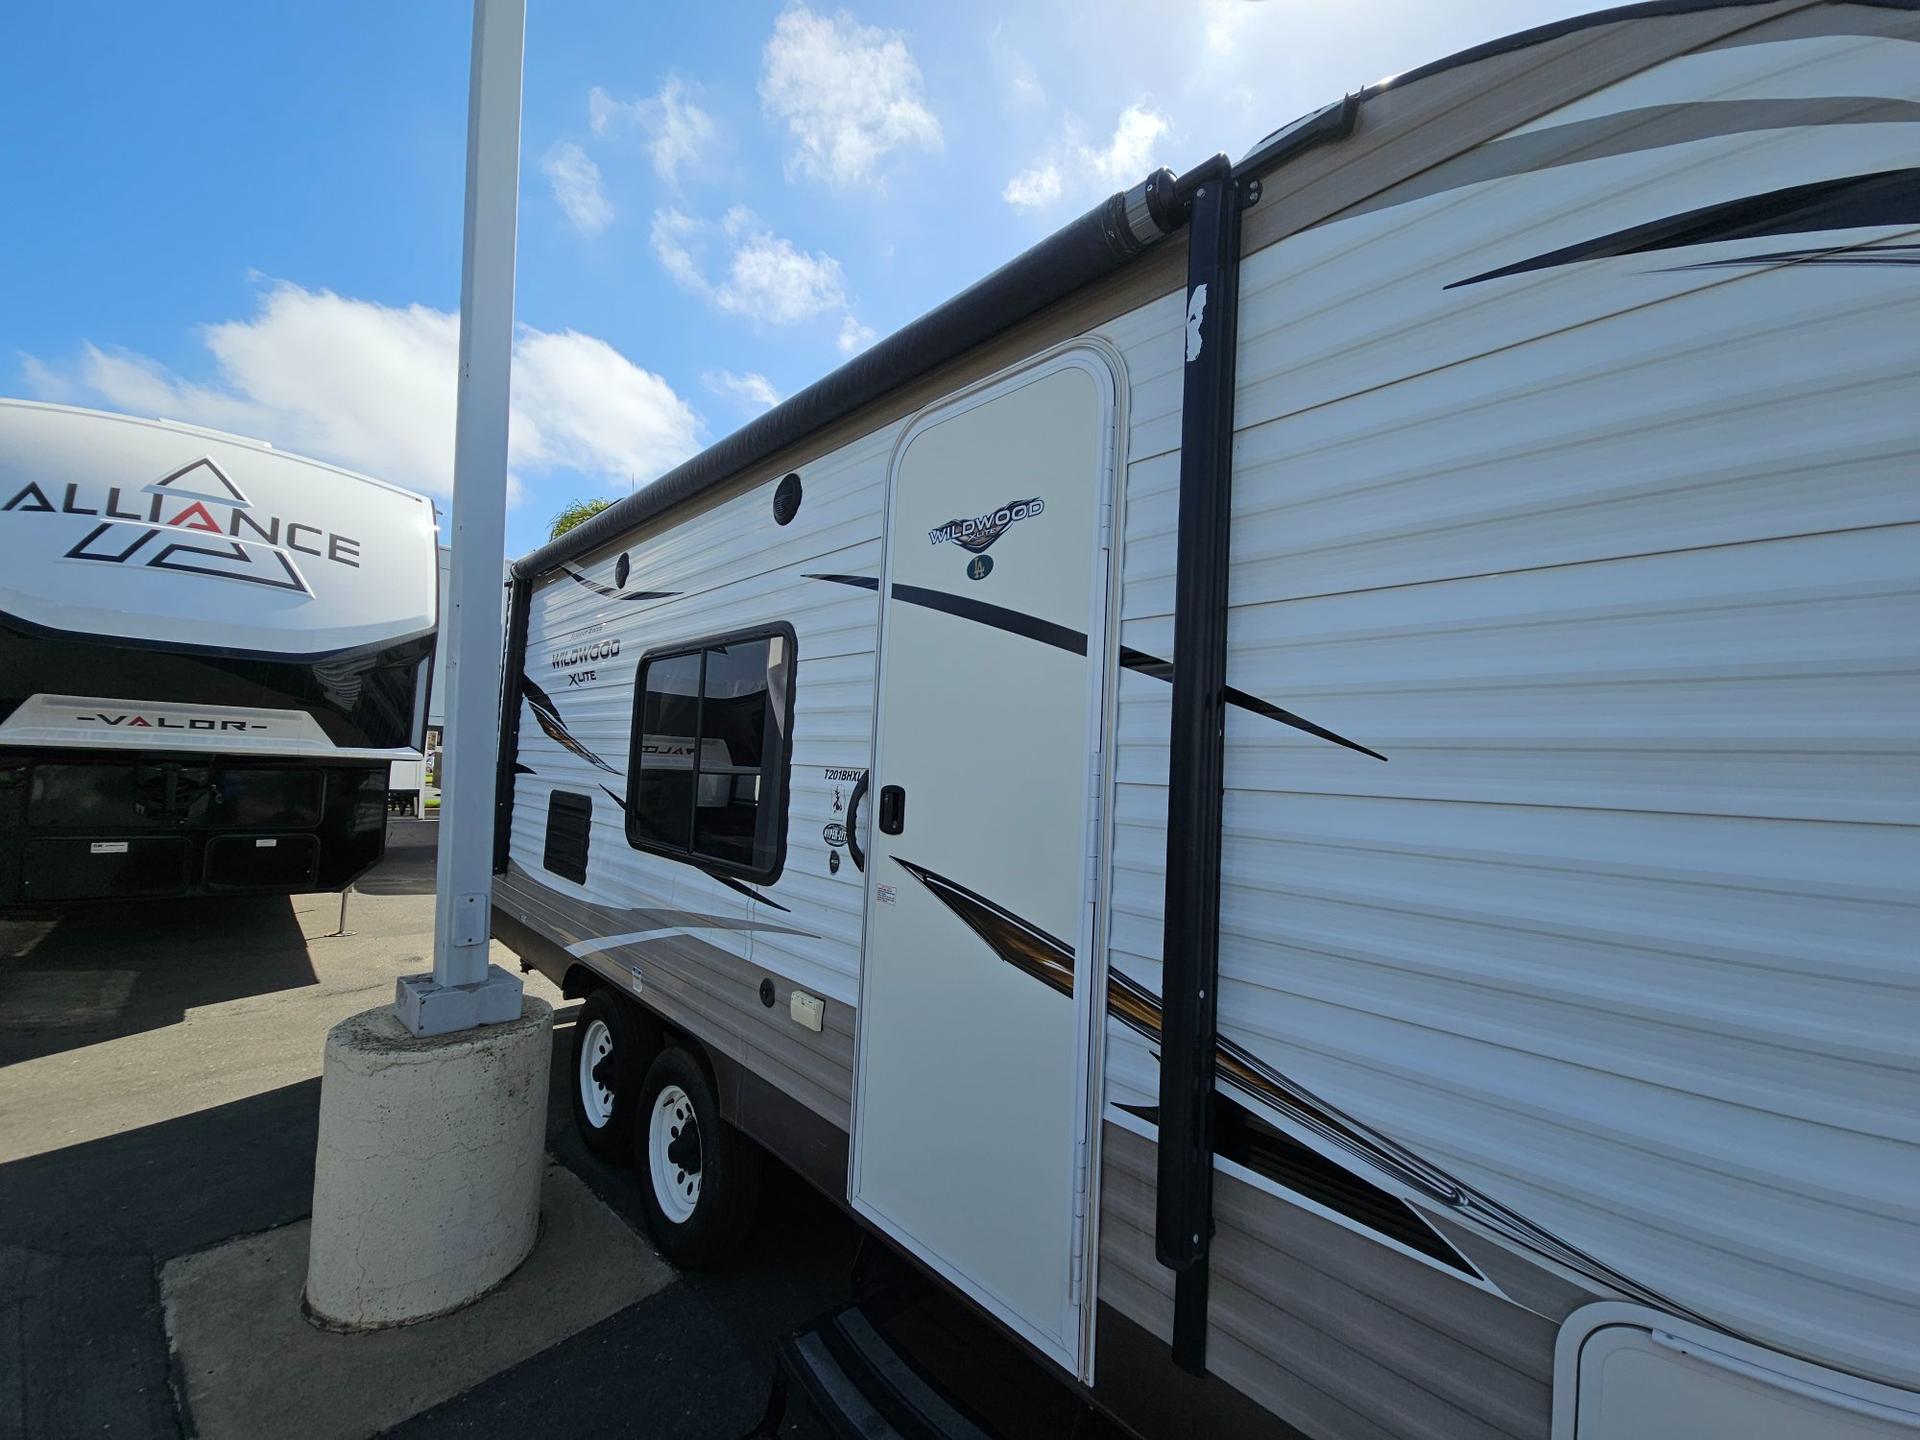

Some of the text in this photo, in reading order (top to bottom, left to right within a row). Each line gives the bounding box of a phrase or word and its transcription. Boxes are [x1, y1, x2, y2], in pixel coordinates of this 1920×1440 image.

[1, 481, 361, 568] ALLIANCE
[927, 500, 1045, 545] WILDWOOD
[552, 639, 620, 669] WILDWOOD
